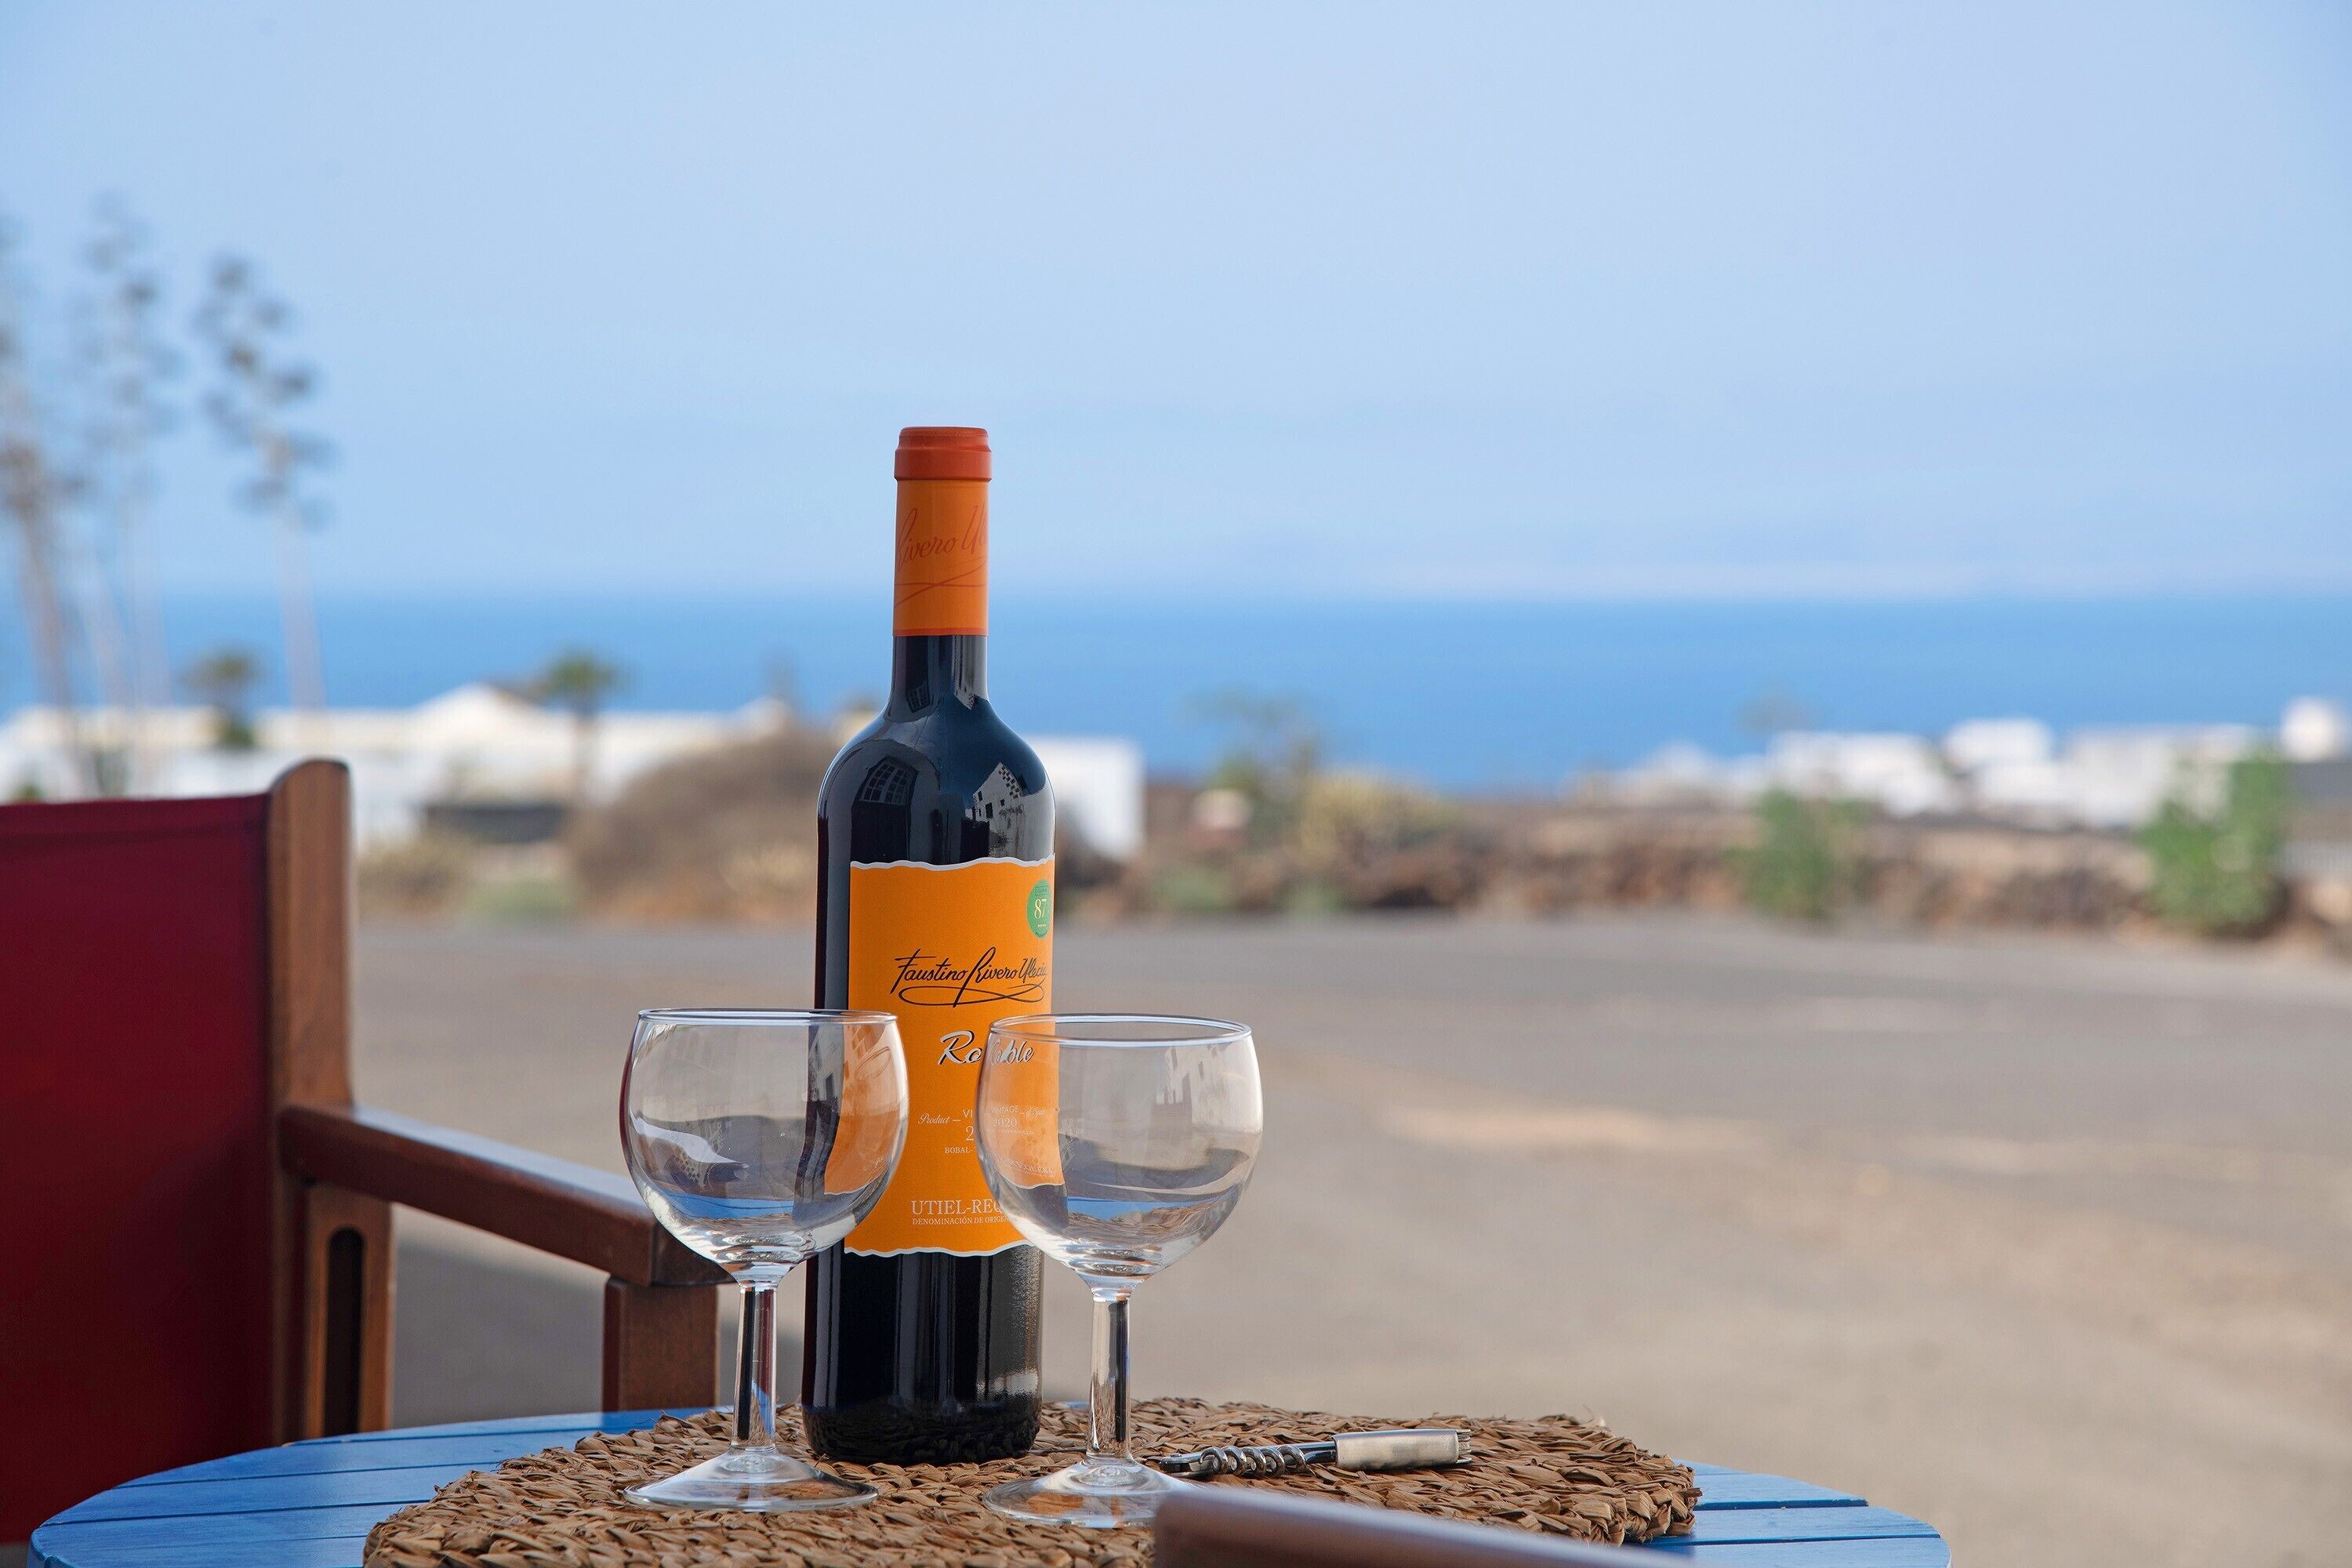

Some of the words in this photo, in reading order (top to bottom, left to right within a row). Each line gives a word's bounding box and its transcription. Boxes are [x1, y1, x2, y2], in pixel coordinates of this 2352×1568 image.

[1034, 898, 1047, 919] 87
[890, 948, 967, 994] Faustino
[953, 946, 1018, 1007] Rivero
[917, 1112, 950, 1124] Product
[913, 1216, 972, 1225] DENOMINACIÓN
